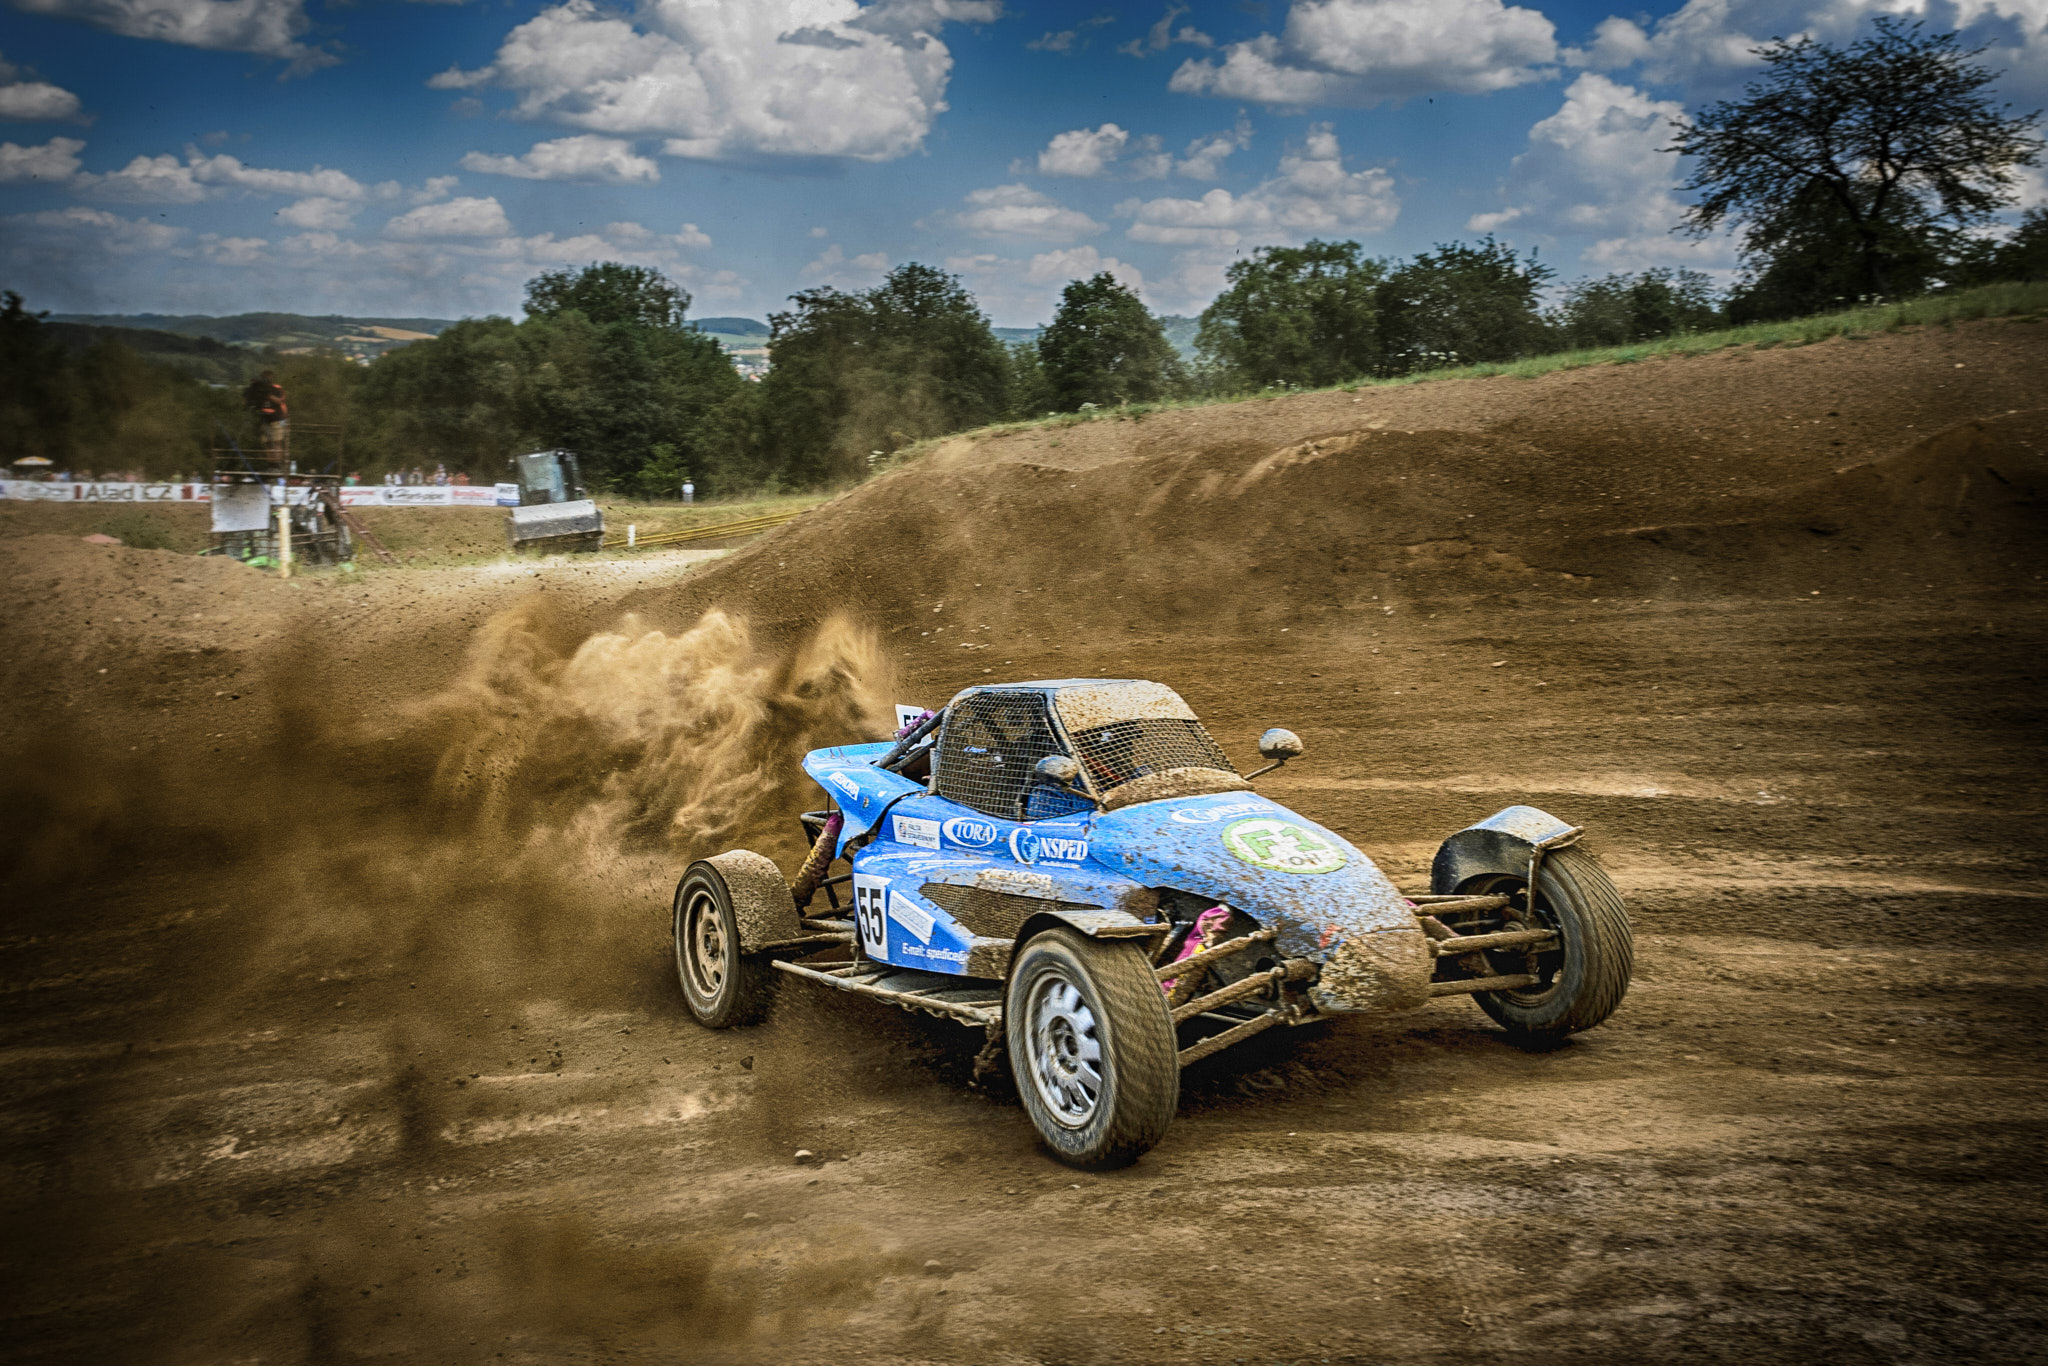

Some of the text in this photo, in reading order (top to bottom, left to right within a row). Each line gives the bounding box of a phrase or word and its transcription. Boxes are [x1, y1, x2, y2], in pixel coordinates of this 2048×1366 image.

[955, 821, 992, 842] TORA
[1239, 826, 1327, 859] F1
[857, 887, 883, 946] 55
